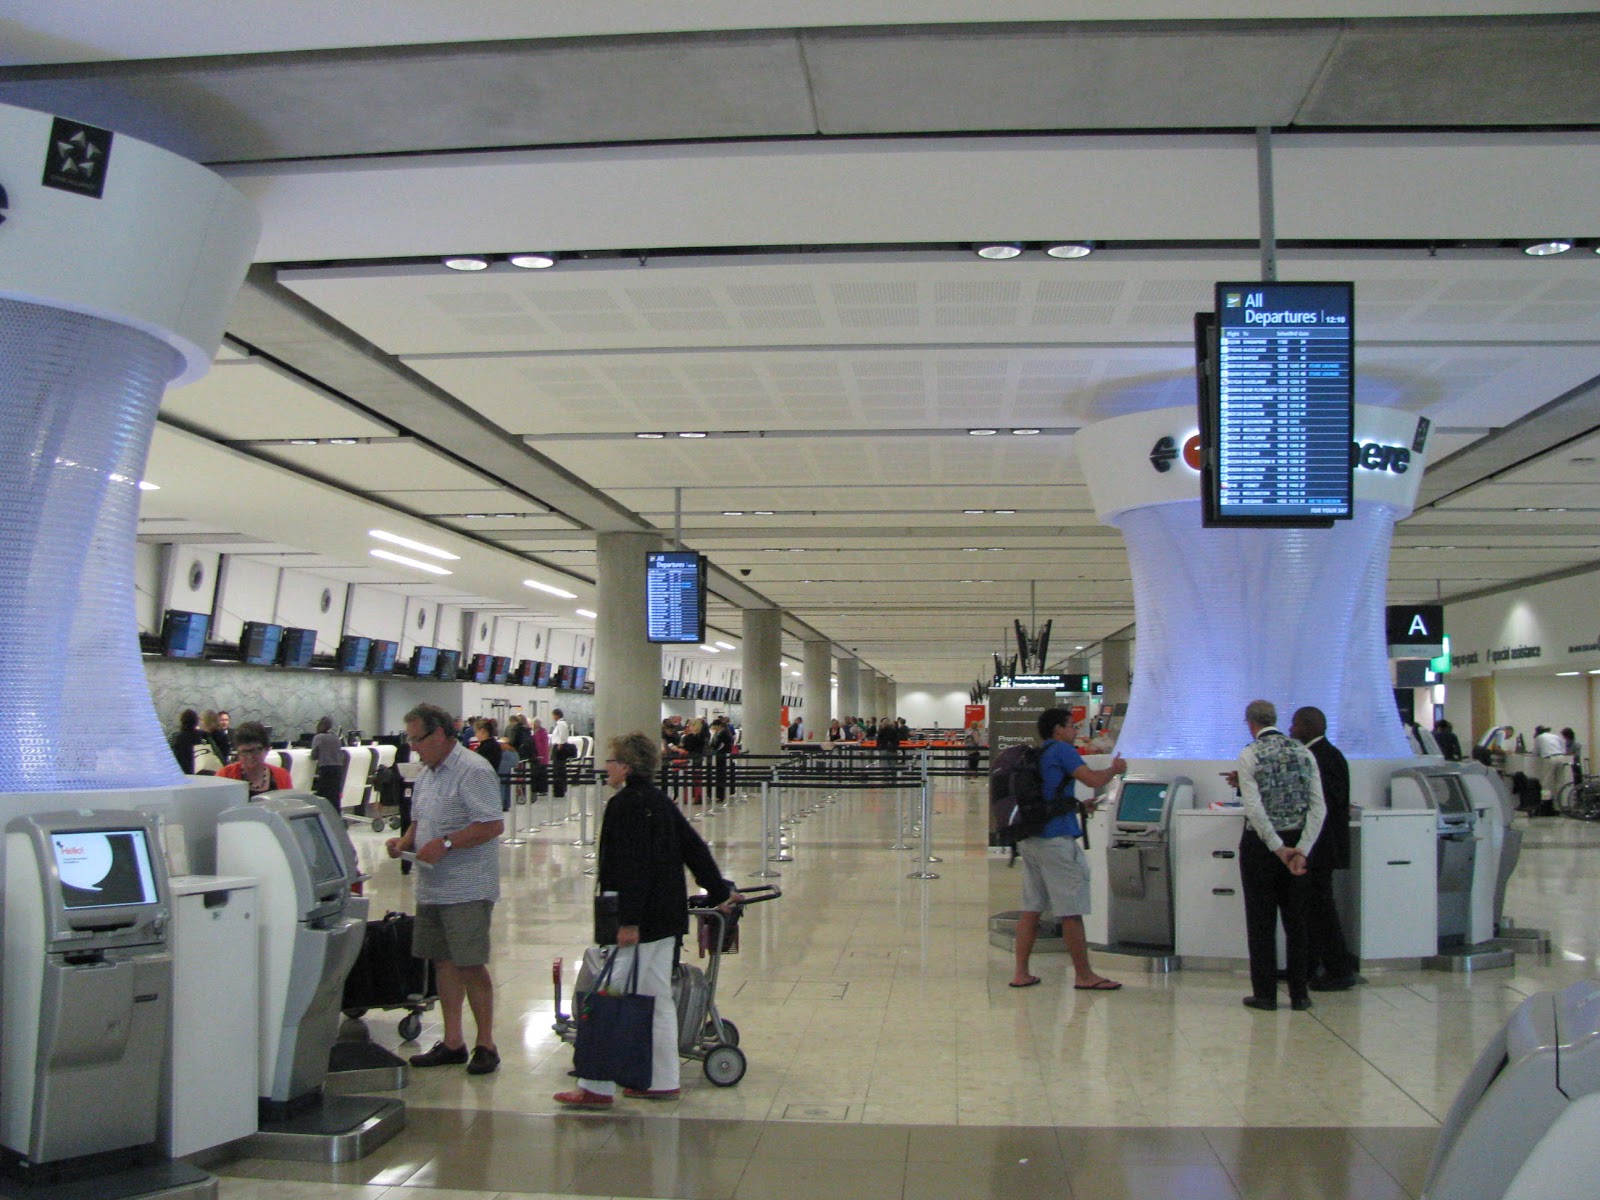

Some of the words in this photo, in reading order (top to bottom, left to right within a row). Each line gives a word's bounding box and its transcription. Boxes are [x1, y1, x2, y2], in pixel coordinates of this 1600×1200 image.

[1245, 293, 1263, 308] All
[1245, 309, 1317, 327] Departures
[1326, 316, 1346, 324] 12:10
[657, 562, 685, 570] Departures
[1408, 614, 1428, 636] A
